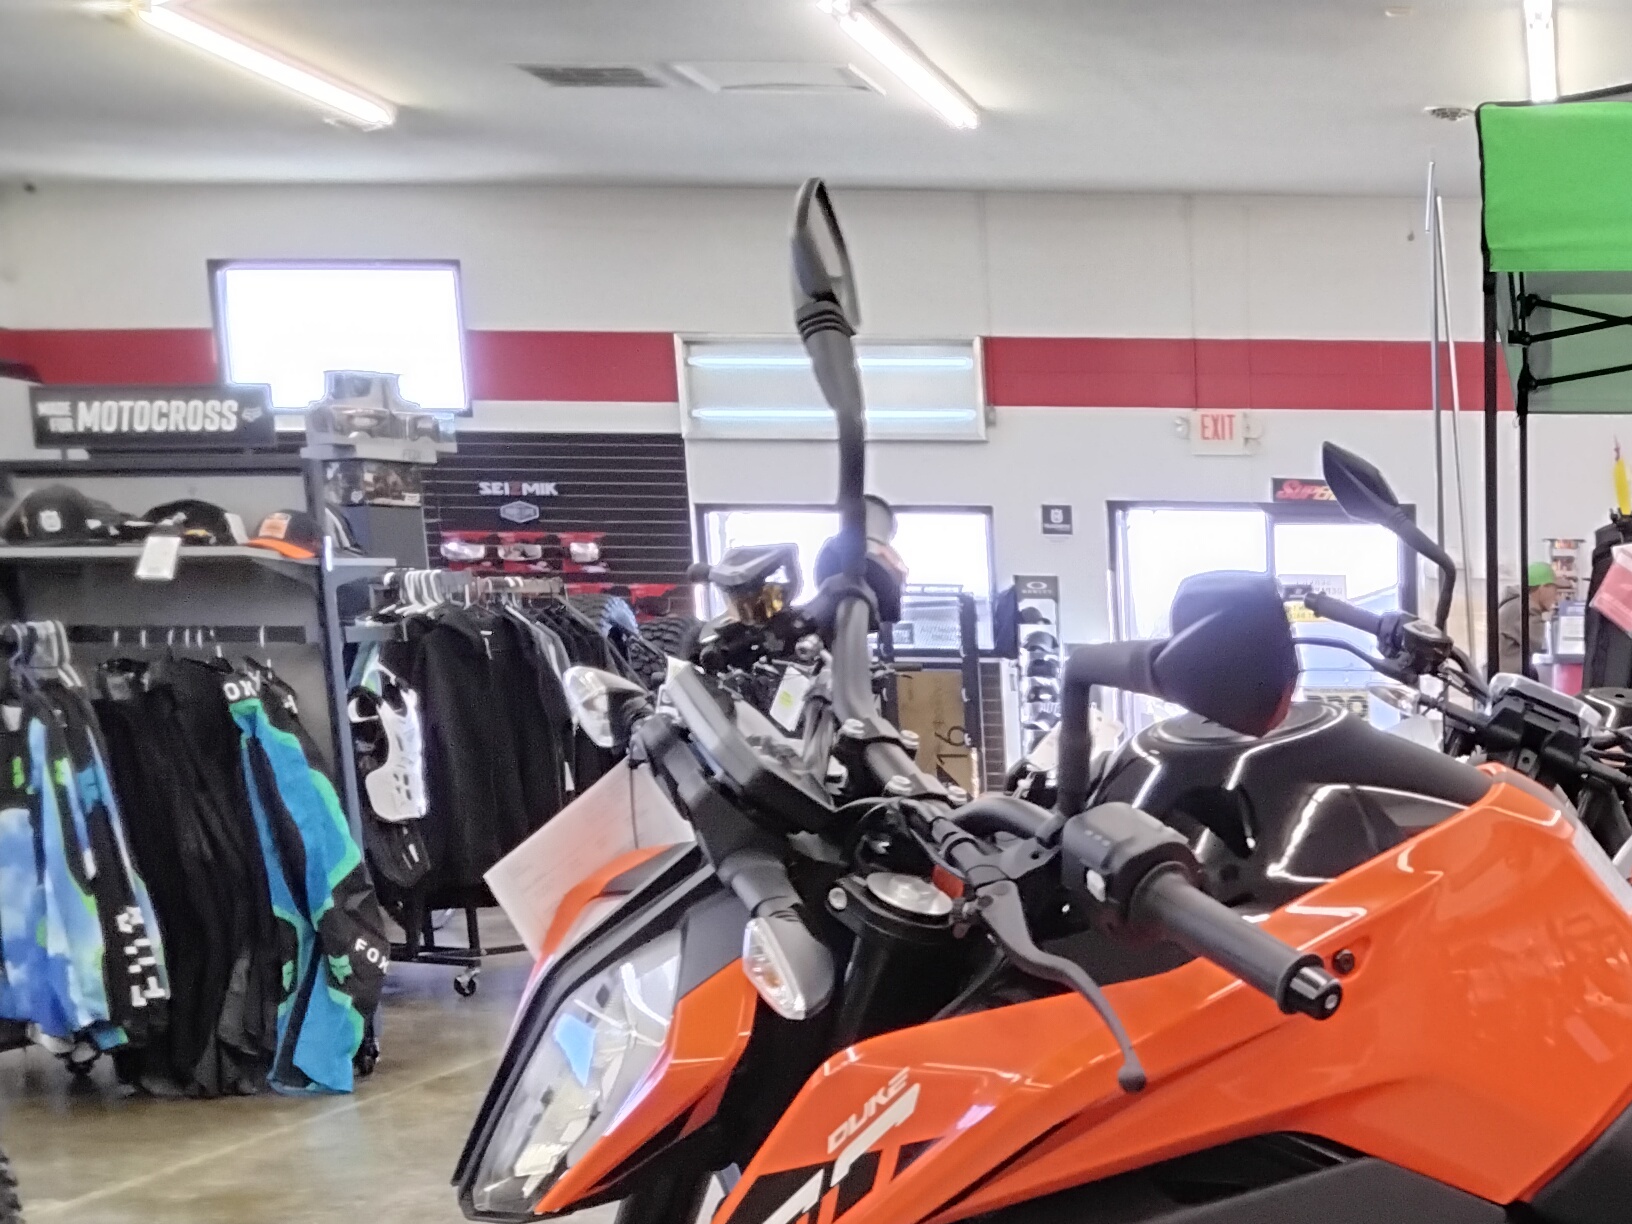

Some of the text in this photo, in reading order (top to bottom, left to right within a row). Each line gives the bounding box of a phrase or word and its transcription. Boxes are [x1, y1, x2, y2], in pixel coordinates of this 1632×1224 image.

[76, 400, 238, 433] MOTOCROSS
[1200, 414, 1236, 441] EXIT
[478, 481, 559, 497] SEIZMIK
[354, 937, 390, 974] FOX
[827, 1066, 911, 1155] DUKE
